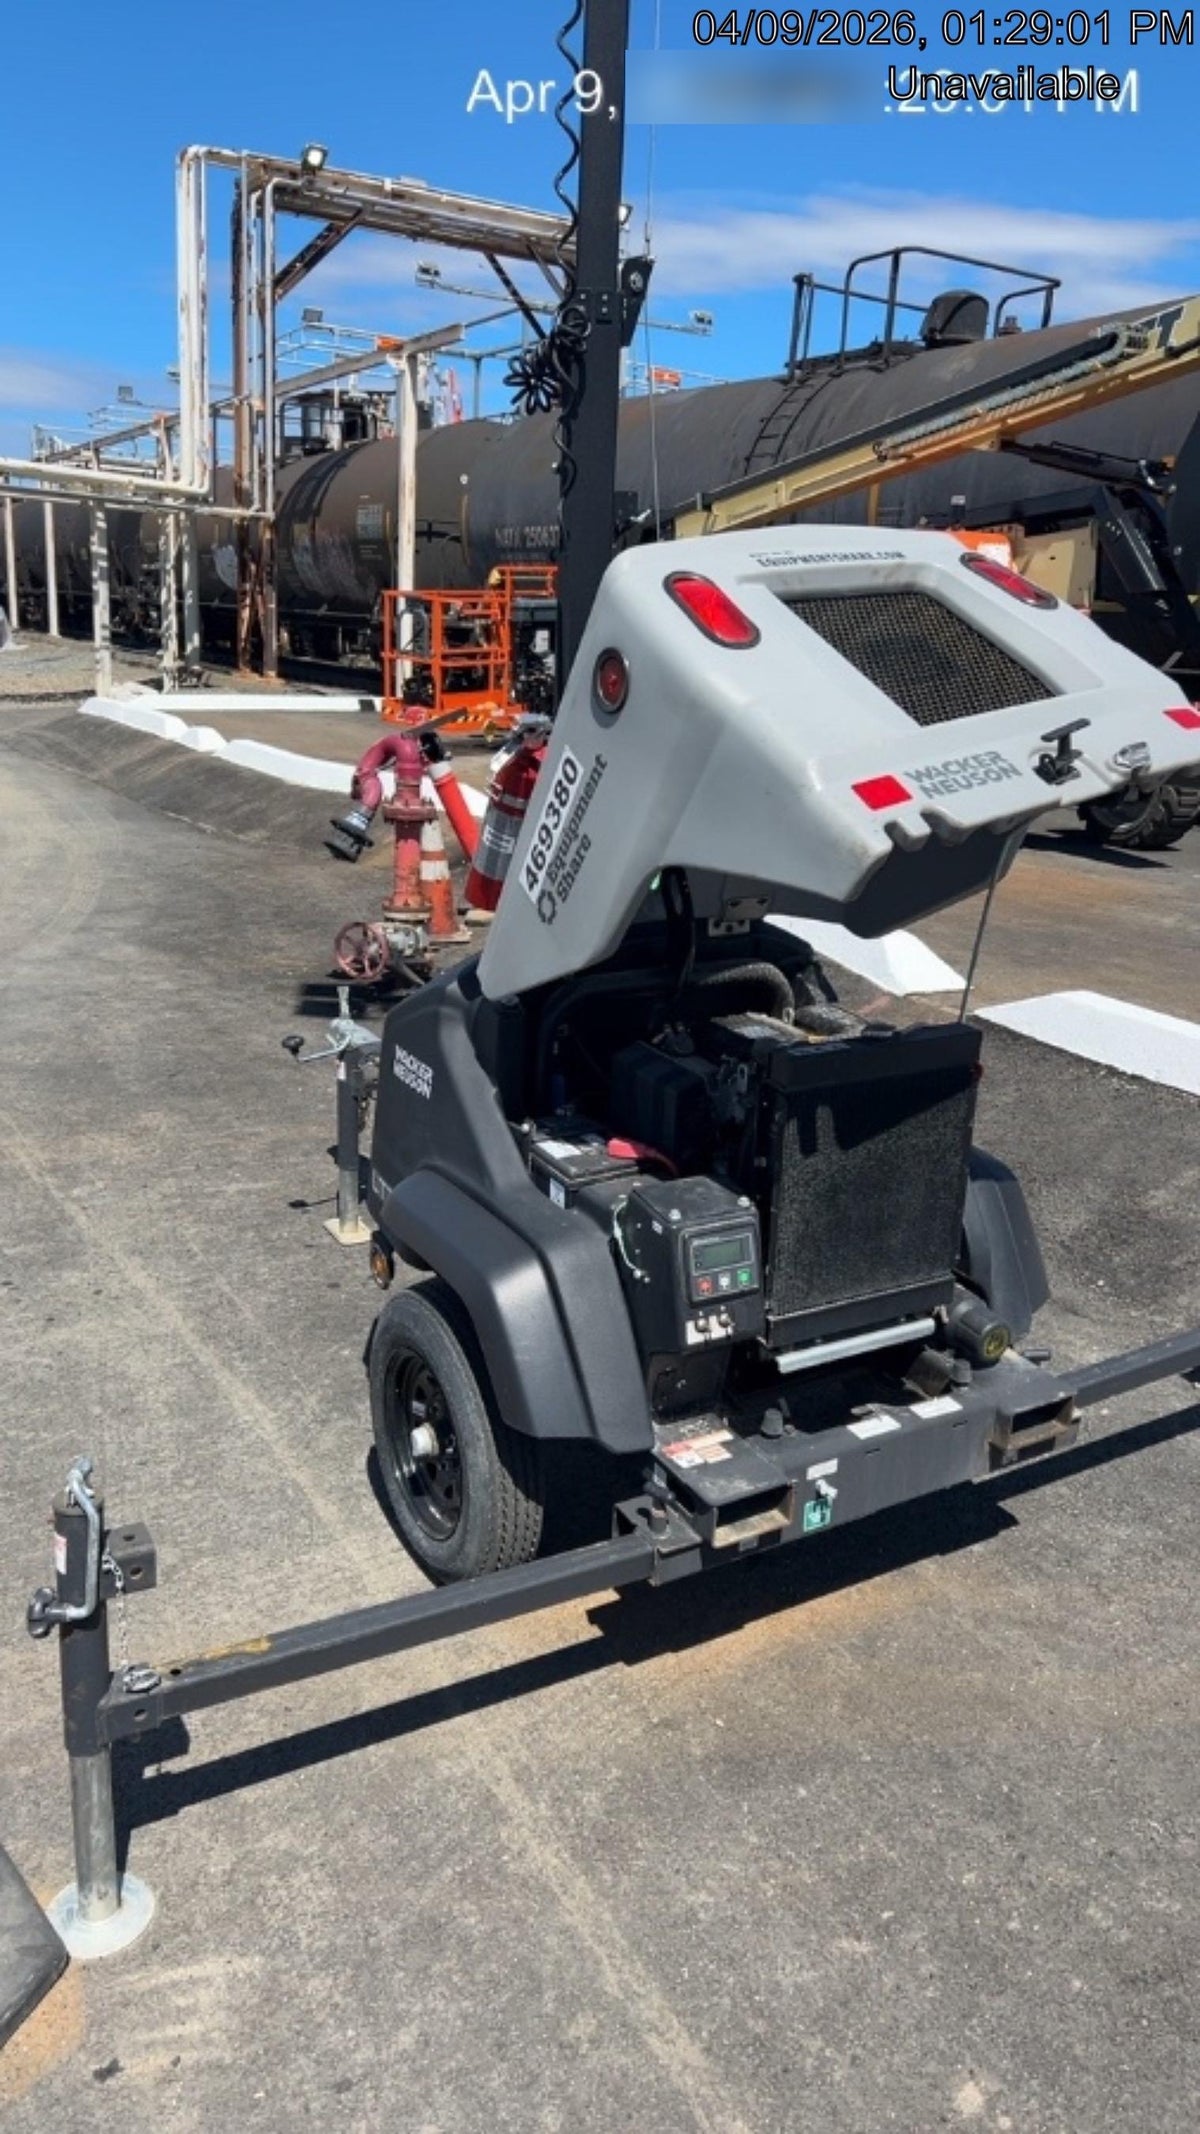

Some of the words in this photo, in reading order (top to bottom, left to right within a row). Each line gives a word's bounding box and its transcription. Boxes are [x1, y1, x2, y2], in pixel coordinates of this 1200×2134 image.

[904, 750, 1010, 784] WACKER
[919, 762, 1024, 800] NEUSON
[524, 757, 579, 892] 469380
[546, 753, 609, 885] Equipment
[556, 833, 592, 904] Share
[393, 1058, 432, 1100] NEUSON
[395, 1044, 433, 1085] WACKER
